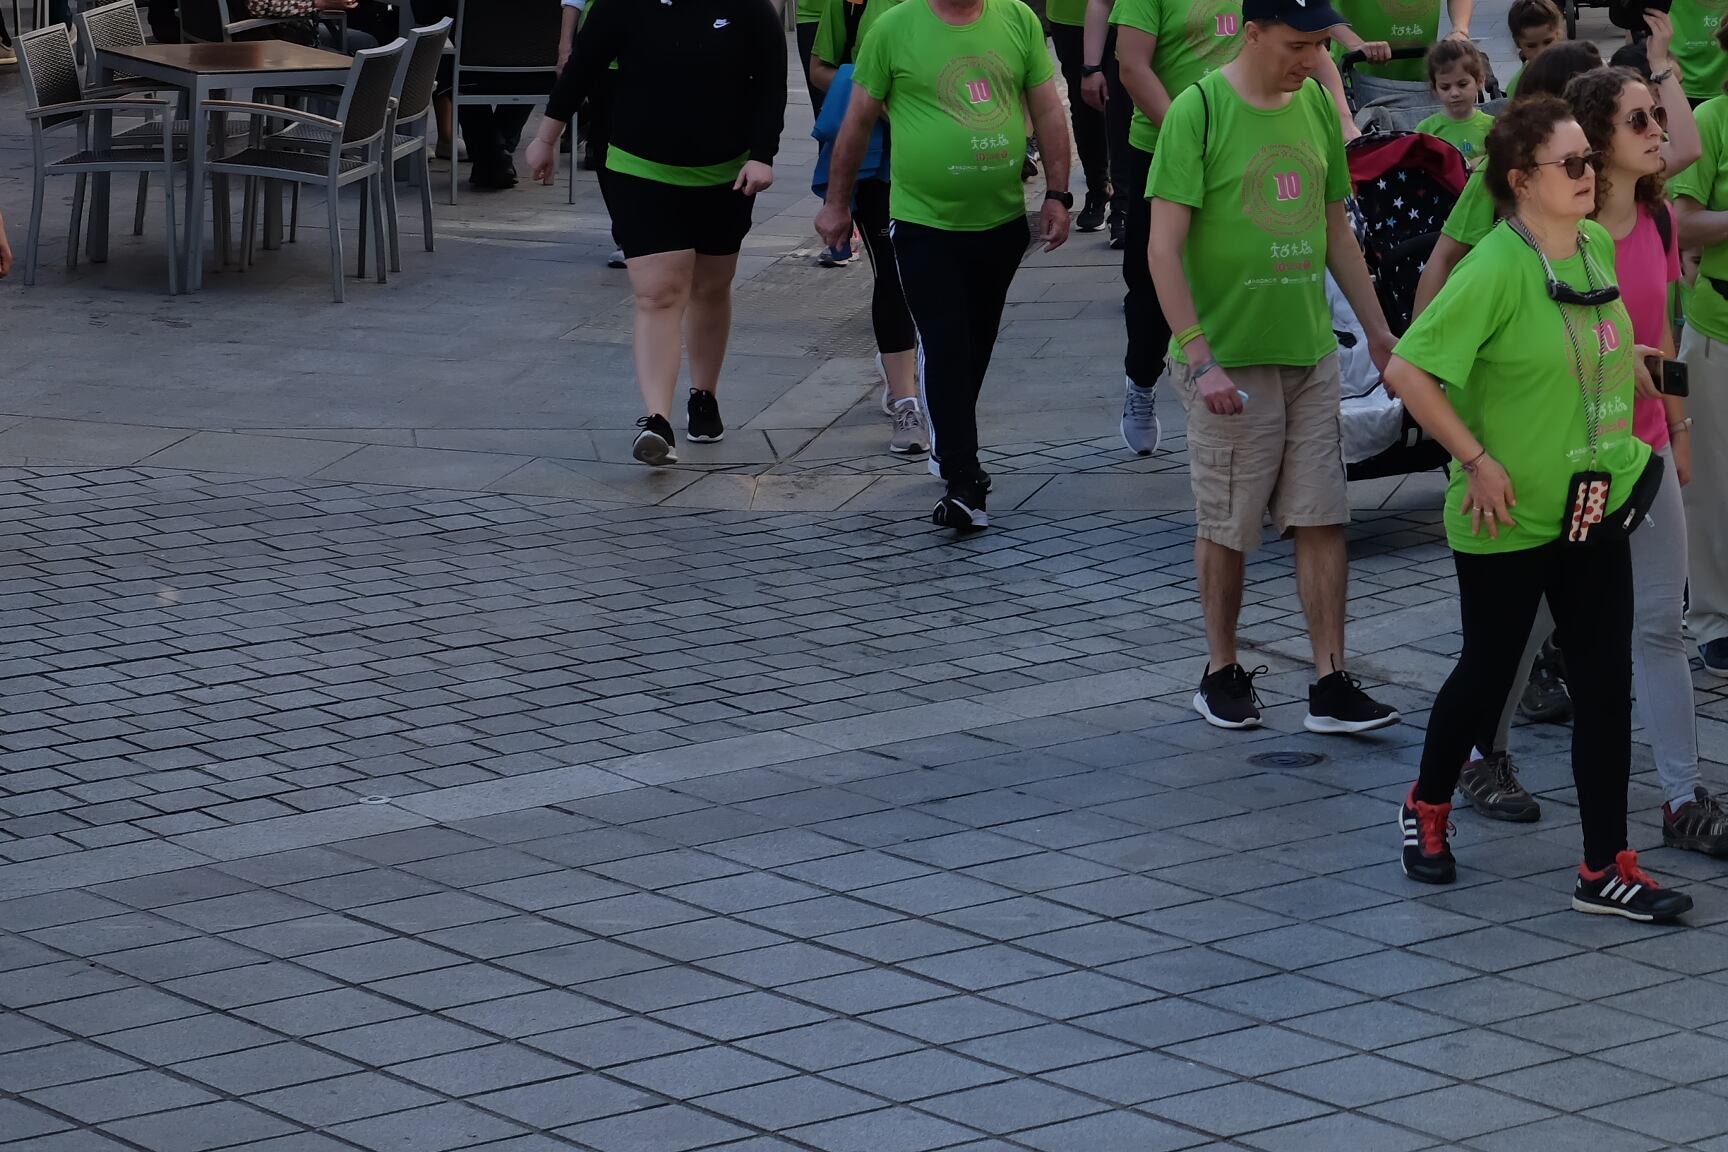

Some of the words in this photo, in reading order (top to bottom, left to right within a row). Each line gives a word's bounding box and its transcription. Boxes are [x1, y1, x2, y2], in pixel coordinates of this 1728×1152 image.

[1214, 12, 1239, 37] 10
[966, 78, 992, 104] 10
[1273, 171, 1302, 202] 10
